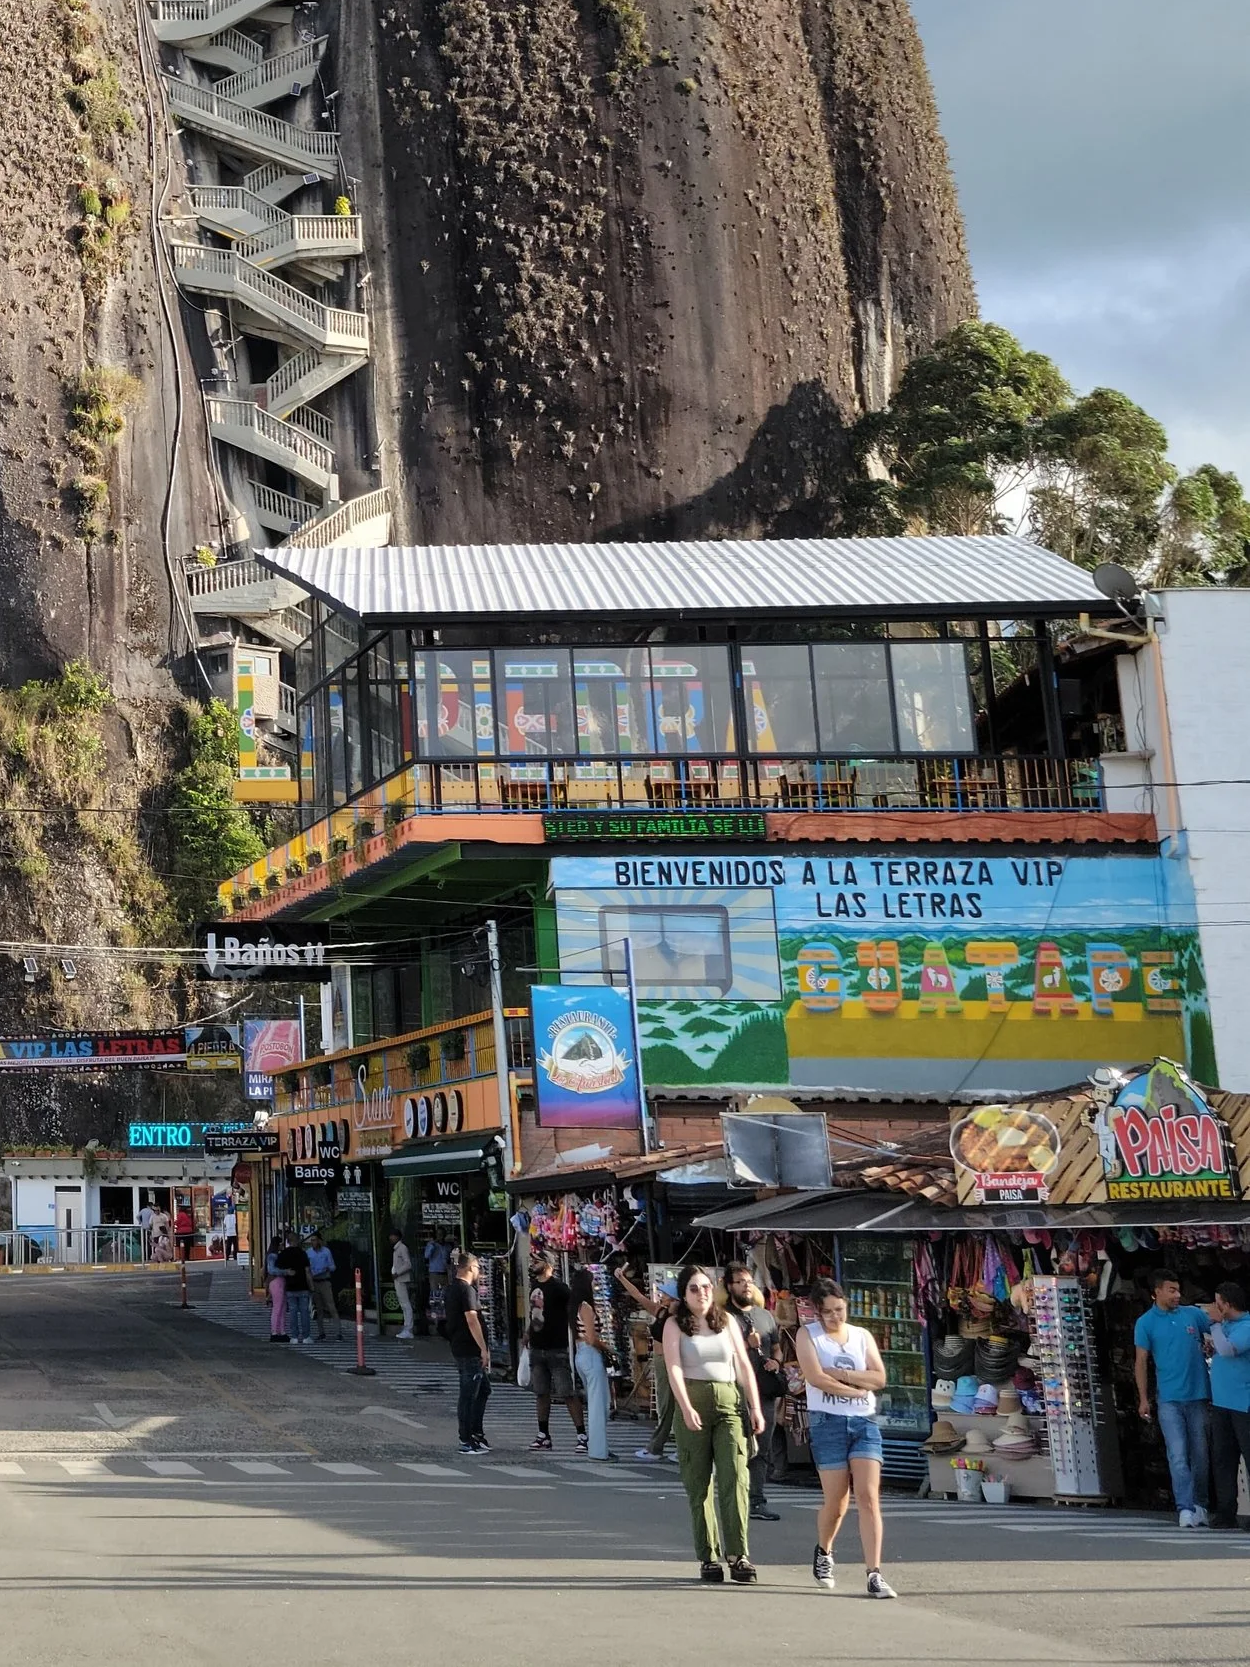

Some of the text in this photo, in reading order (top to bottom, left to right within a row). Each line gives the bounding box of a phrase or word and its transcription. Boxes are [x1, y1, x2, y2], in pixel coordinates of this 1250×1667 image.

[594, 819, 604, 833] Y
[609, 819, 631, 833] SU
[637, 819, 707, 834] FAMILIA
[713, 819, 734, 833] SE
[614, 860, 785, 886] BIENVENIDOS
[801, 860, 816, 886] A
[827, 860, 857, 886] LA
[870, 860, 993, 886] TERRAZA
[815, 892, 982, 920] LAS LETRAS
[224, 936, 300, 966] Baños
[796, 940, 1183, 1016] GUATAPE
[9, 1042, 46, 1059] VIP
[50, 1040, 93, 1058] LAS
[97, 1037, 181, 1057] LETRAS
[197, 1040, 236, 1054] PIEDRA
[248, 1086, 262, 1096] LA
[207, 1135, 278, 1147] TERRAZA VIP
[319, 1146, 340, 1159] WC
[294, 1165, 335, 1179] Baños
[437, 1181, 460, 1196] WC
[981, 1173, 1039, 1189] Bandeja
[999, 1188, 1023, 1200] PAISA
[1109, 1180, 1232, 1200] RESTAURANTE
